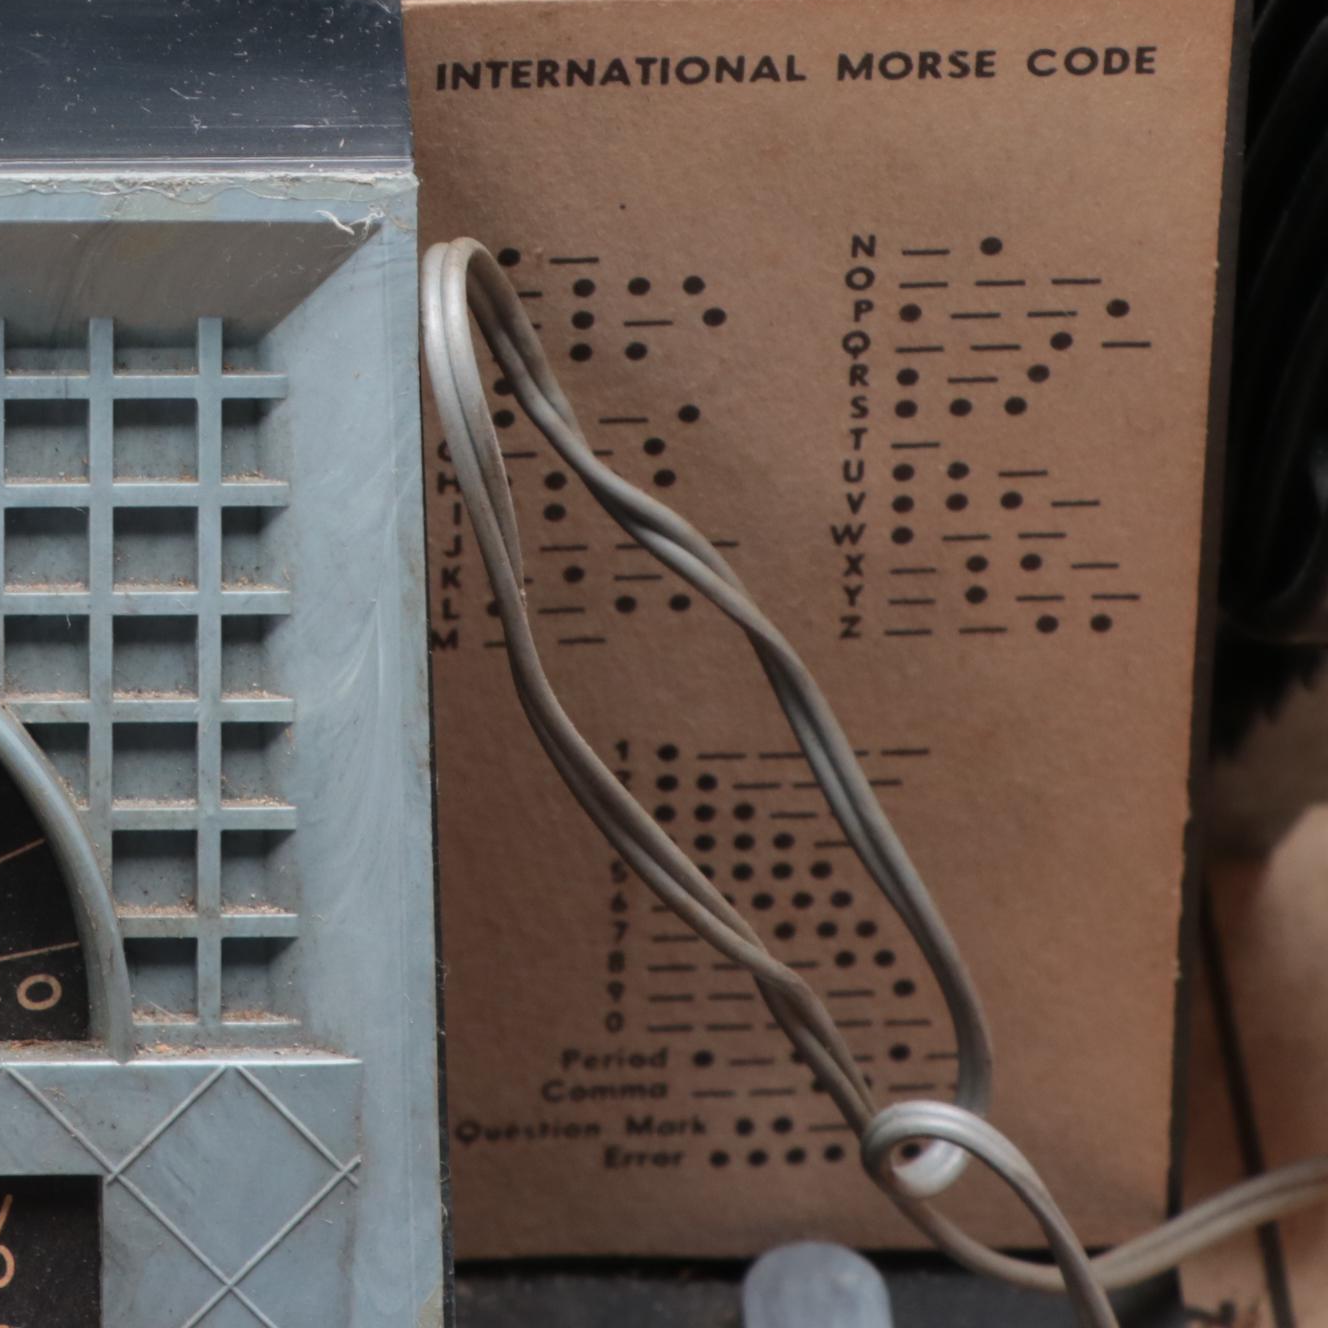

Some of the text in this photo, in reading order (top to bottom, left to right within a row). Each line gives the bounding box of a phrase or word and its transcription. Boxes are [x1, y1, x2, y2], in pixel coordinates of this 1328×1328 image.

[435, 45, 1158, 91] INTERNATIONAL MORSE CODE
[851, 234, 876, 259] N
[845, 266, 875, 291] O
[853, 299, 874, 323] P
[842, 330, 871, 360] Q
[849, 363, 869, 387] R
[849, 395, 869, 419] S
[849, 427, 868, 451] T
[842, 459, 865, 484] U
[845, 492, 866, 515] V
[443, 534, 463, 558] J
[830, 524, 866, 546] W
[844, 554, 864, 577] X
[441, 566, 462, 590] K
[842, 585, 862, 608] Y
[441, 598, 460, 621] L
[432, 628, 460, 650] M
[839, 615, 861, 639] Z
[560, 1048, 669, 1073] Period
[540, 1078, 670, 1105] Comma
[454, 1115, 707, 1146] Question Mark
[603, 1145, 685, 1171] Error
